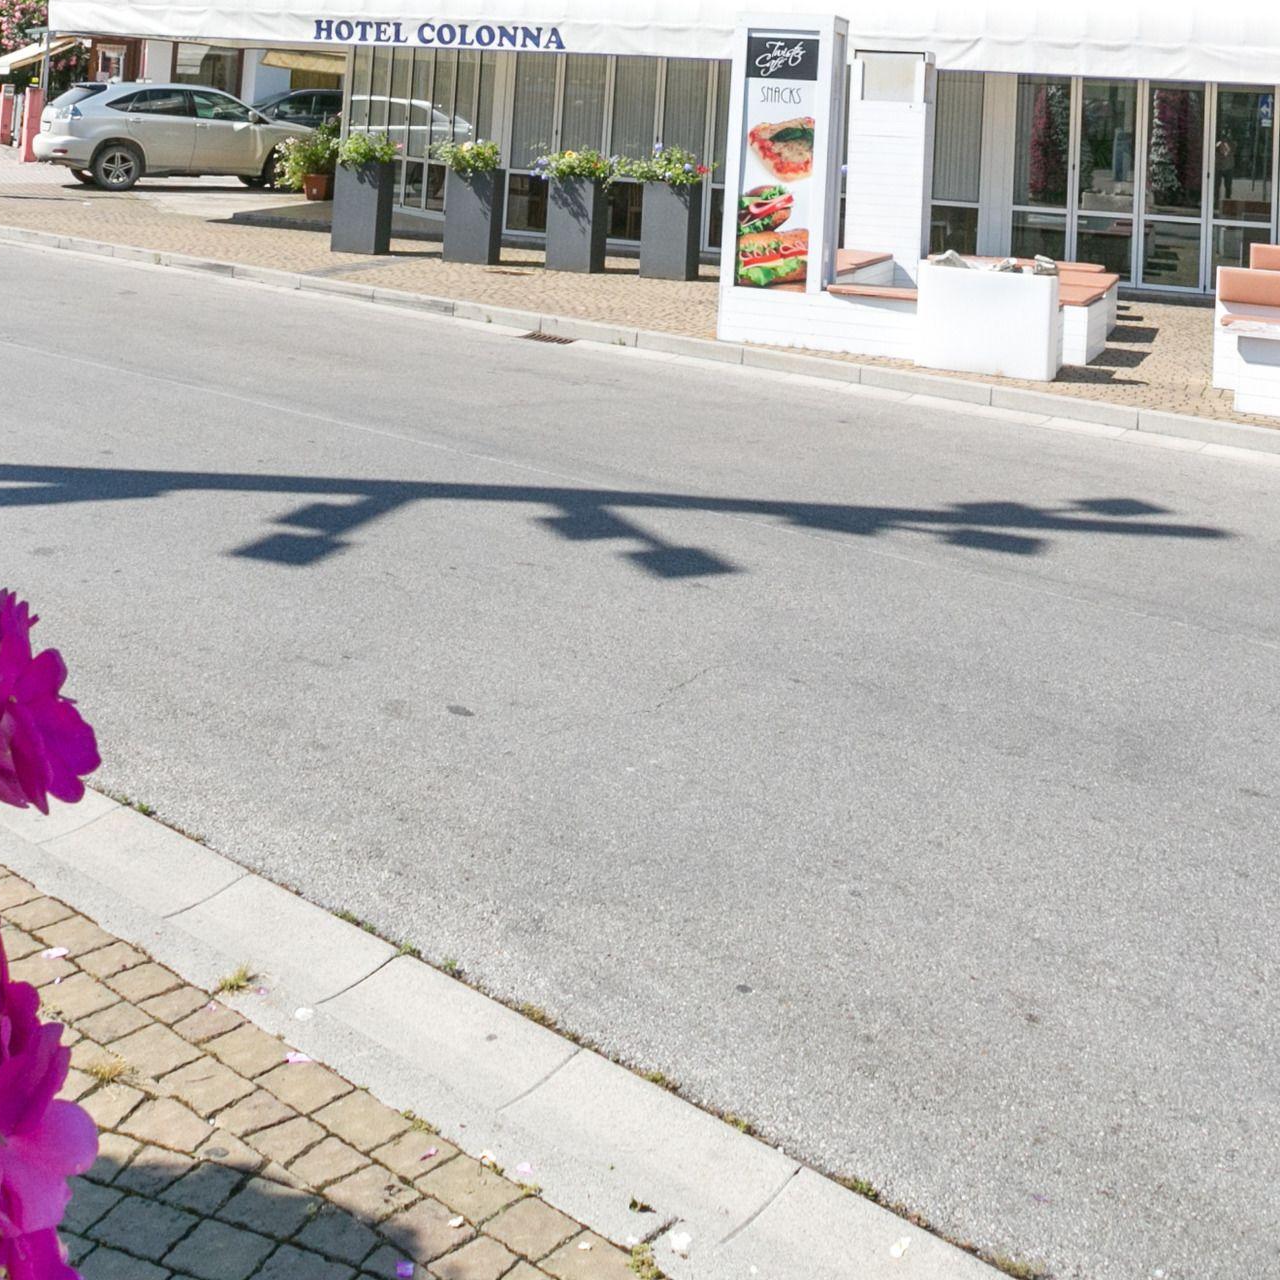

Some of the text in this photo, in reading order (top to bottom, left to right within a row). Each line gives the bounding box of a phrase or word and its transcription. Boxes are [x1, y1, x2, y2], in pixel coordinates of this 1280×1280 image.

[314, 19, 566, 49] HOTEL COLONNA
[760, 86, 802, 104] SNACKS
